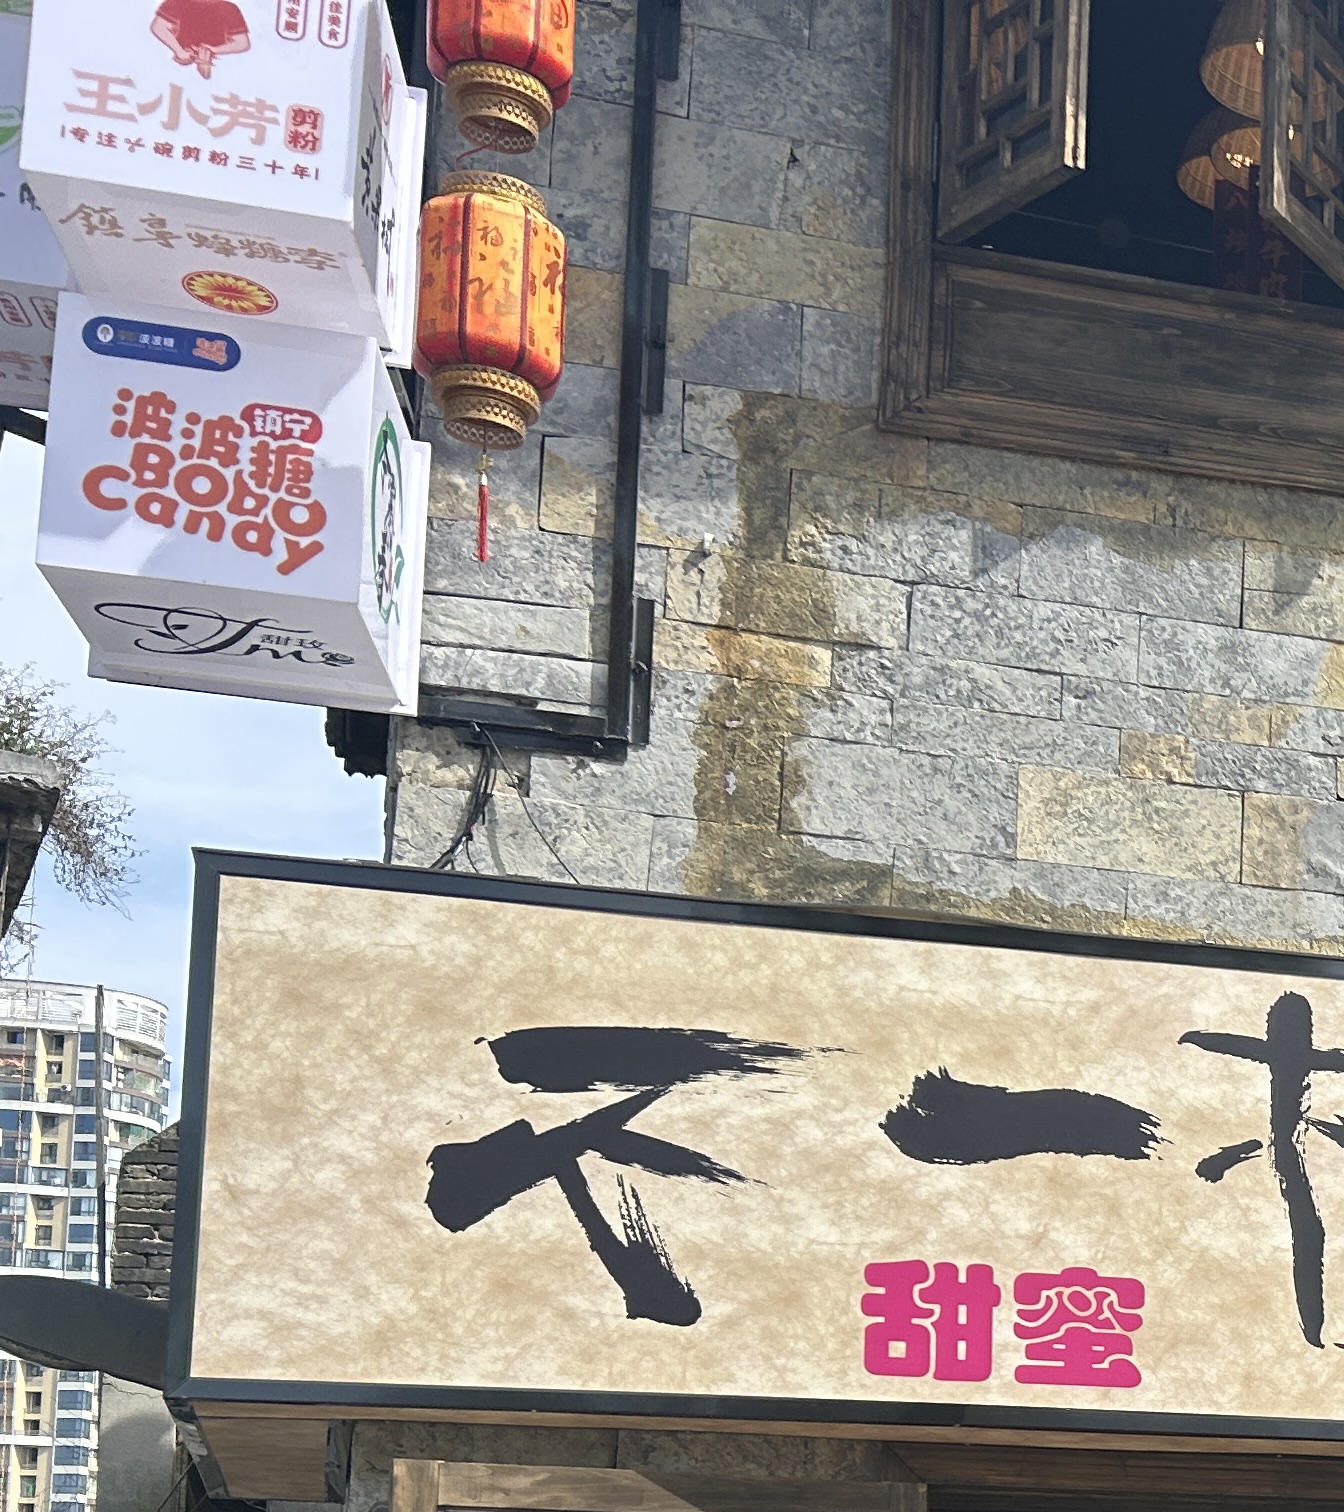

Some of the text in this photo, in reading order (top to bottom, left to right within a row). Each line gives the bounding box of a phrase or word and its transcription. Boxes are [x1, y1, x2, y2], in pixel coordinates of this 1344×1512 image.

[63, 68, 281, 146] 王小芳
[288, 106, 321, 153] 剪粉
[110, 387, 315, 500] 波波糖
[253, 407, 313, 438] 镇宁
[861, 1259, 1145, 1389] 甜蜜
